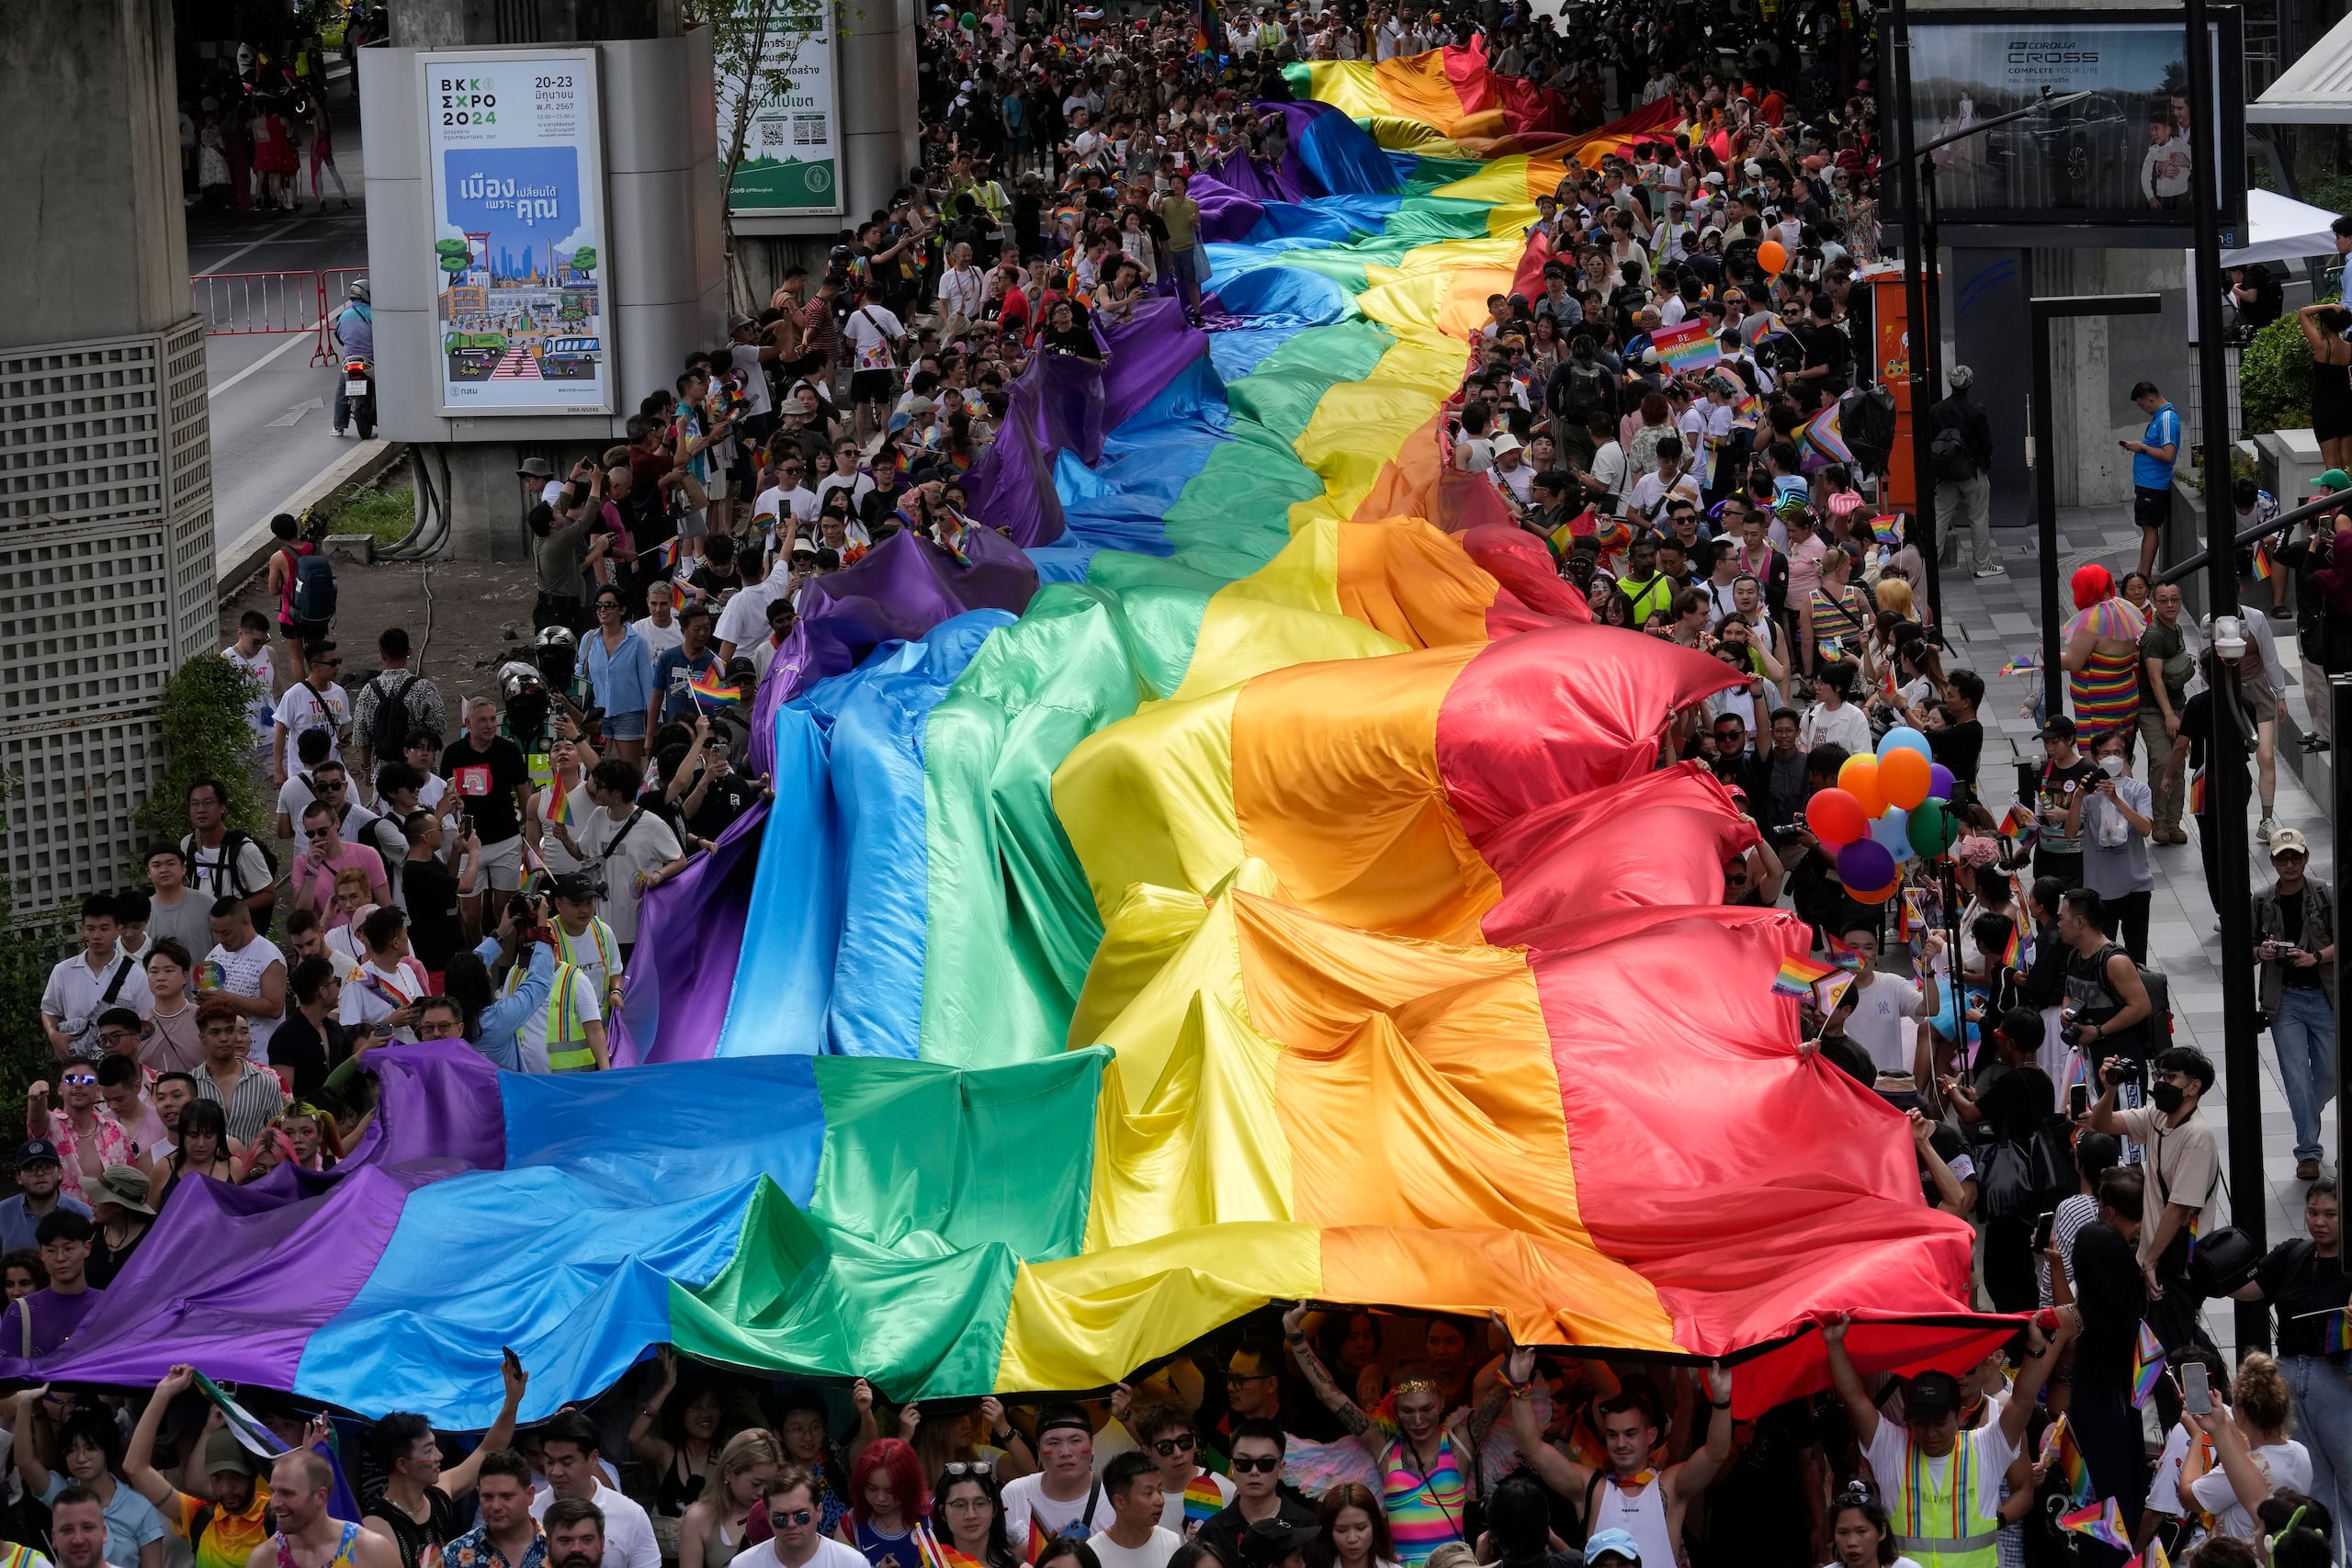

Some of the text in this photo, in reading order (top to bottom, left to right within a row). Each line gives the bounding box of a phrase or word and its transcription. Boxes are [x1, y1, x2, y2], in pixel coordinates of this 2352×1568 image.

[2028, 41, 2075, 50] COROLLA
[2008, 52, 2099, 63] CROSS
[441, 78, 481, 91] BKK
[535, 76, 573, 88] 20-23
[536, 90, 573, 102] มิถุนายน
[443, 111, 496, 126] 2024
[460, 172, 558, 199] เมือง เปลี่ยนได้
[486, 198, 559, 227] เพราะ คุณ
[1677, 333, 1690, 342] BE
[1664, 339, 1706, 354] WHO YOU
[1673, 351, 1691, 361] ARE
[198, 969, 219, 980] MBK
[2247, 1267, 2257, 1278] EOS
